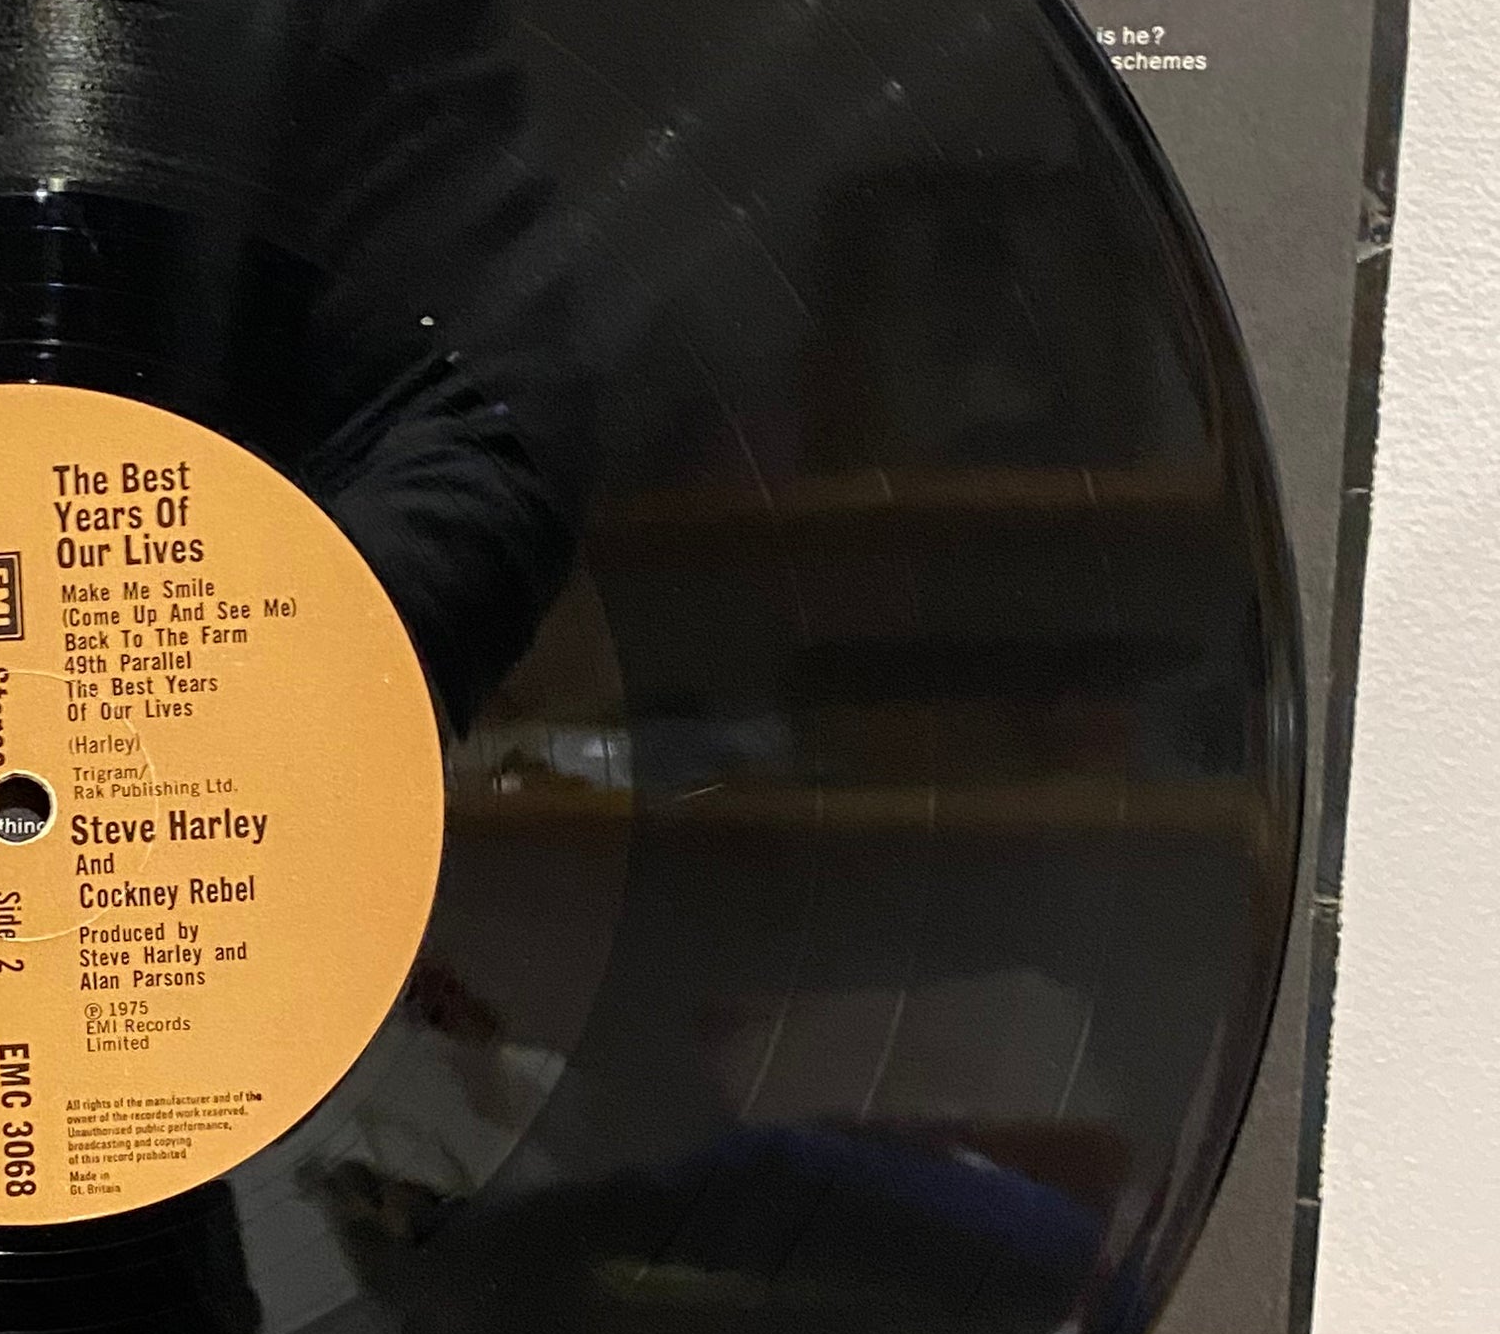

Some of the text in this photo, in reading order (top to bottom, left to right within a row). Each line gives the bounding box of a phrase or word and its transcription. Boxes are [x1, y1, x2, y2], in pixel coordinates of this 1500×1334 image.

[1110, 51, 1207, 70] schemes
[51, 460, 190, 497] The Best
[52, 494, 189, 533] Years Of
[56, 532, 204, 569] Our Lives
[61, 577, 215, 603] Make Me Smile
[62, 596, 297, 628] (Come Up And See Me)
[64, 624, 247, 652] Back To The Farm
[63, 650, 191, 675] 49th Parallel
[63, 674, 218, 702] The Best Years
[67, 698, 193, 722] Of Our Lives
[68, 733, 140, 756] (Harley)
[71, 763, 148, 784] Trigram/
[73, 777, 238, 800] Rak Publishing Ltd.
[70, 809, 268, 846] Steve Harley
[75, 851, 115, 876] And
[79, 874, 255, 911] Cockney Rebel
[78, 920, 199, 945] Produced by
[79, 940, 247, 968] Steve Harley and
[79, 969, 206, 991] Alan Parsons
[108, 999, 149, 1017] 1975
[85, 1015, 191, 1035] EMI Records
[86, 1034, 150, 1053] Limited
[2, 1120, 37, 1198] 3068
